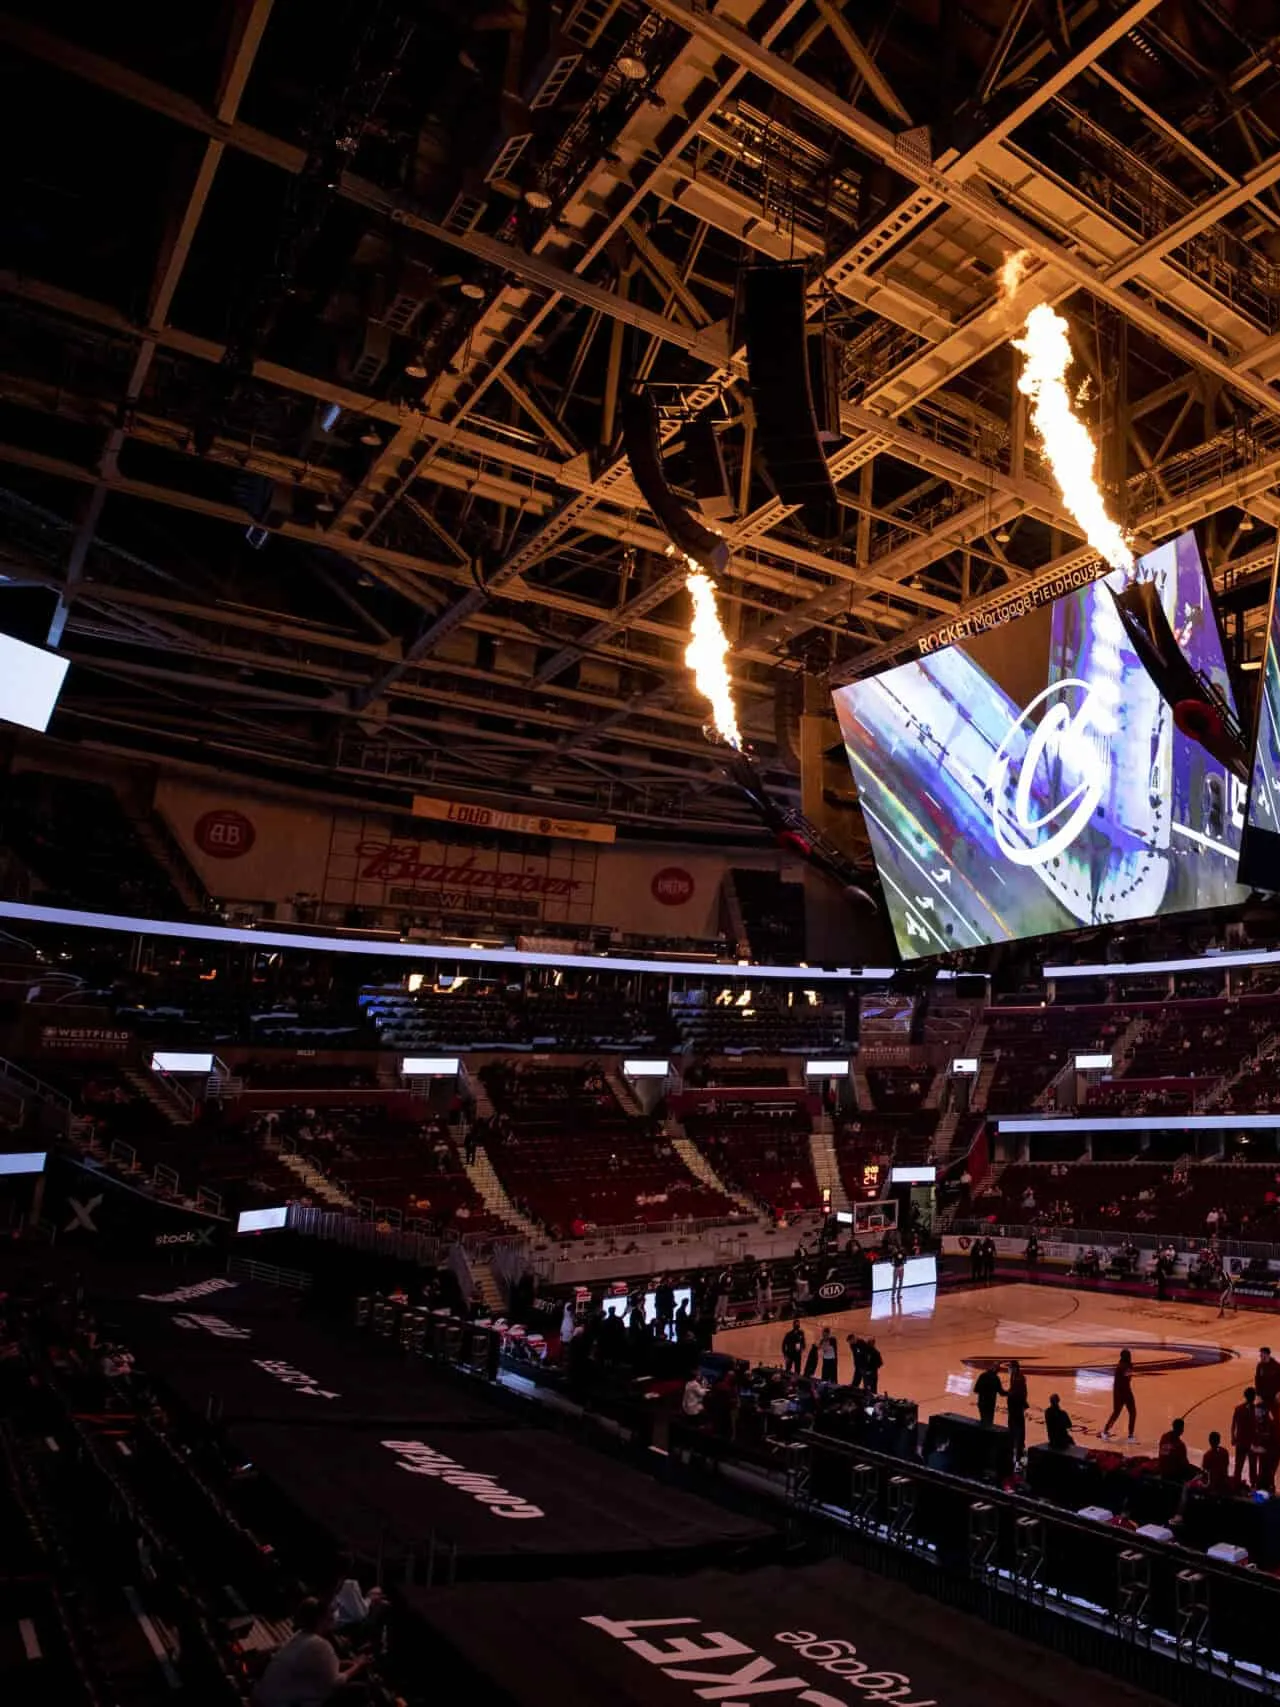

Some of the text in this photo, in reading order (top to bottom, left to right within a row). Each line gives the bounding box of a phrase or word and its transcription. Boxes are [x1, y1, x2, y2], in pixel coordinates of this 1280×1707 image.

[918, 561, 1102, 654] ROCKET Mortgage FIELDHOUSE
[448, 804, 537, 832] LOUDVILLE
[210, 823, 241, 845] AB
[356, 841, 582, 895] Budweiser
[58, 1028, 128, 1039] WESTFIELD
[863, 1173, 878, 1185] 24
[821, 1285, 842, 1298] KIA
